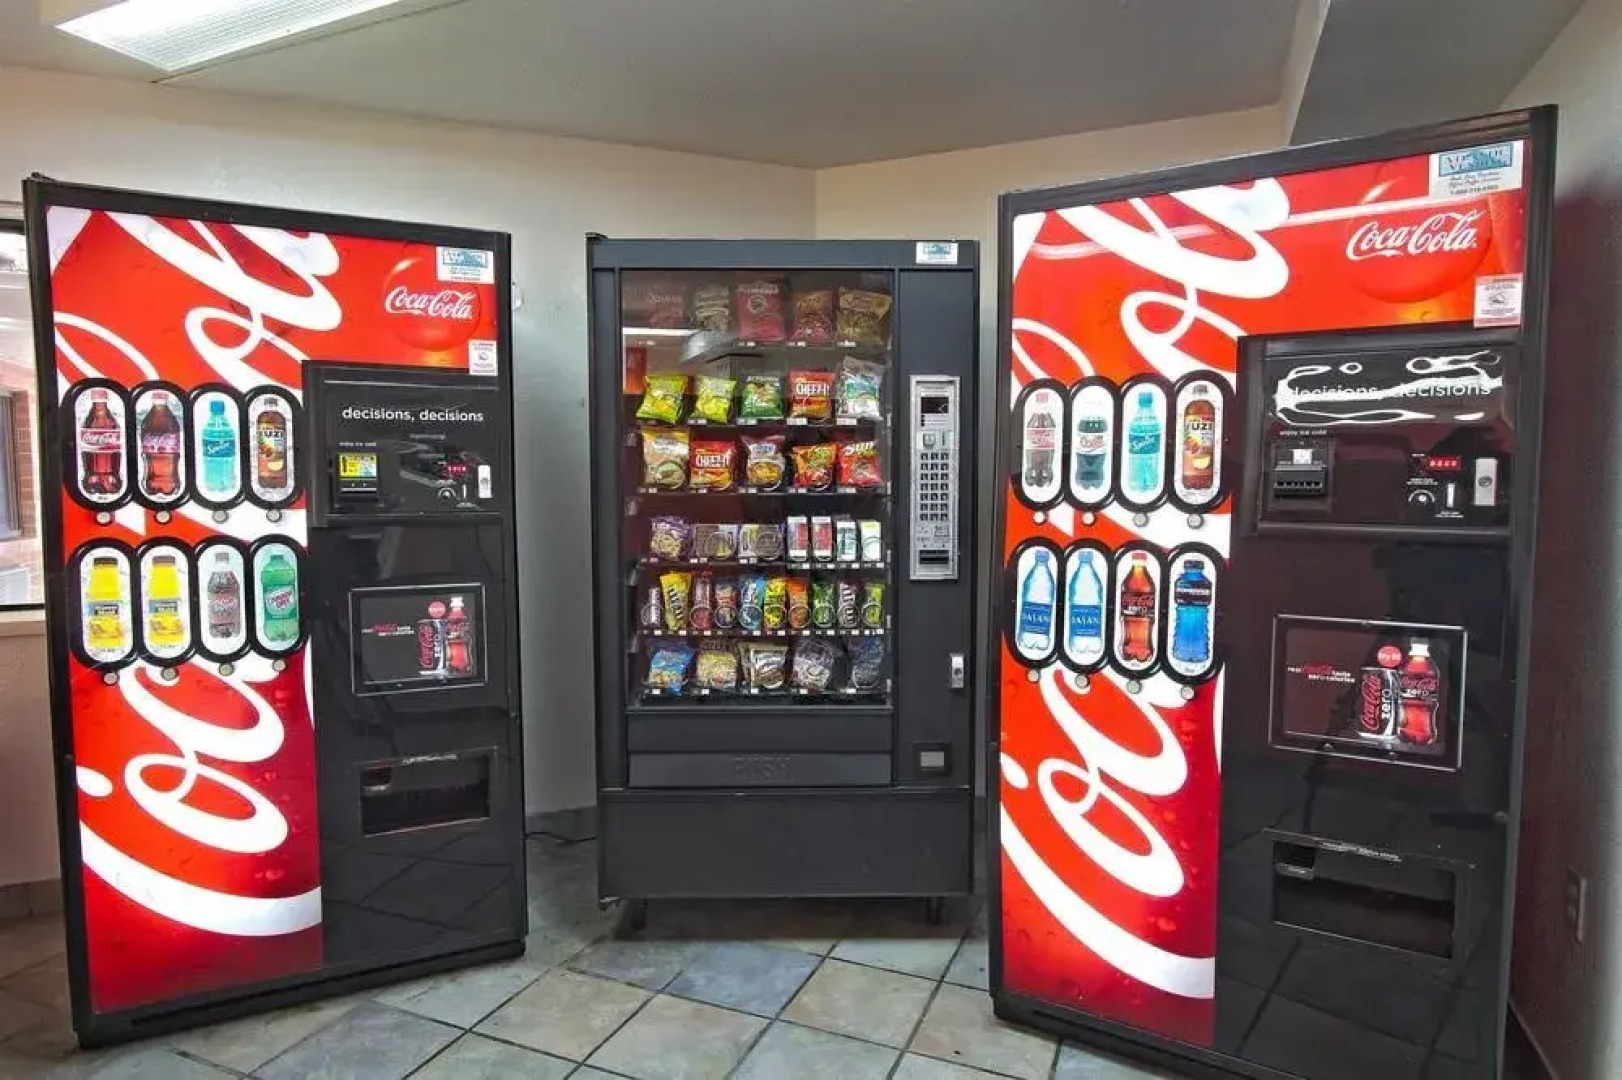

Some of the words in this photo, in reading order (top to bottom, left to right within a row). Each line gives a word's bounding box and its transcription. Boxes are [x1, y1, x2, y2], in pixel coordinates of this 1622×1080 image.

[1346, 209, 1486, 261] Coca-Cola
[384, 286, 477, 320] Coca-Cola
[342, 407, 415, 421] decisions,
[419, 409, 484, 421] decisions
[1381, 688, 1391, 719] zero
